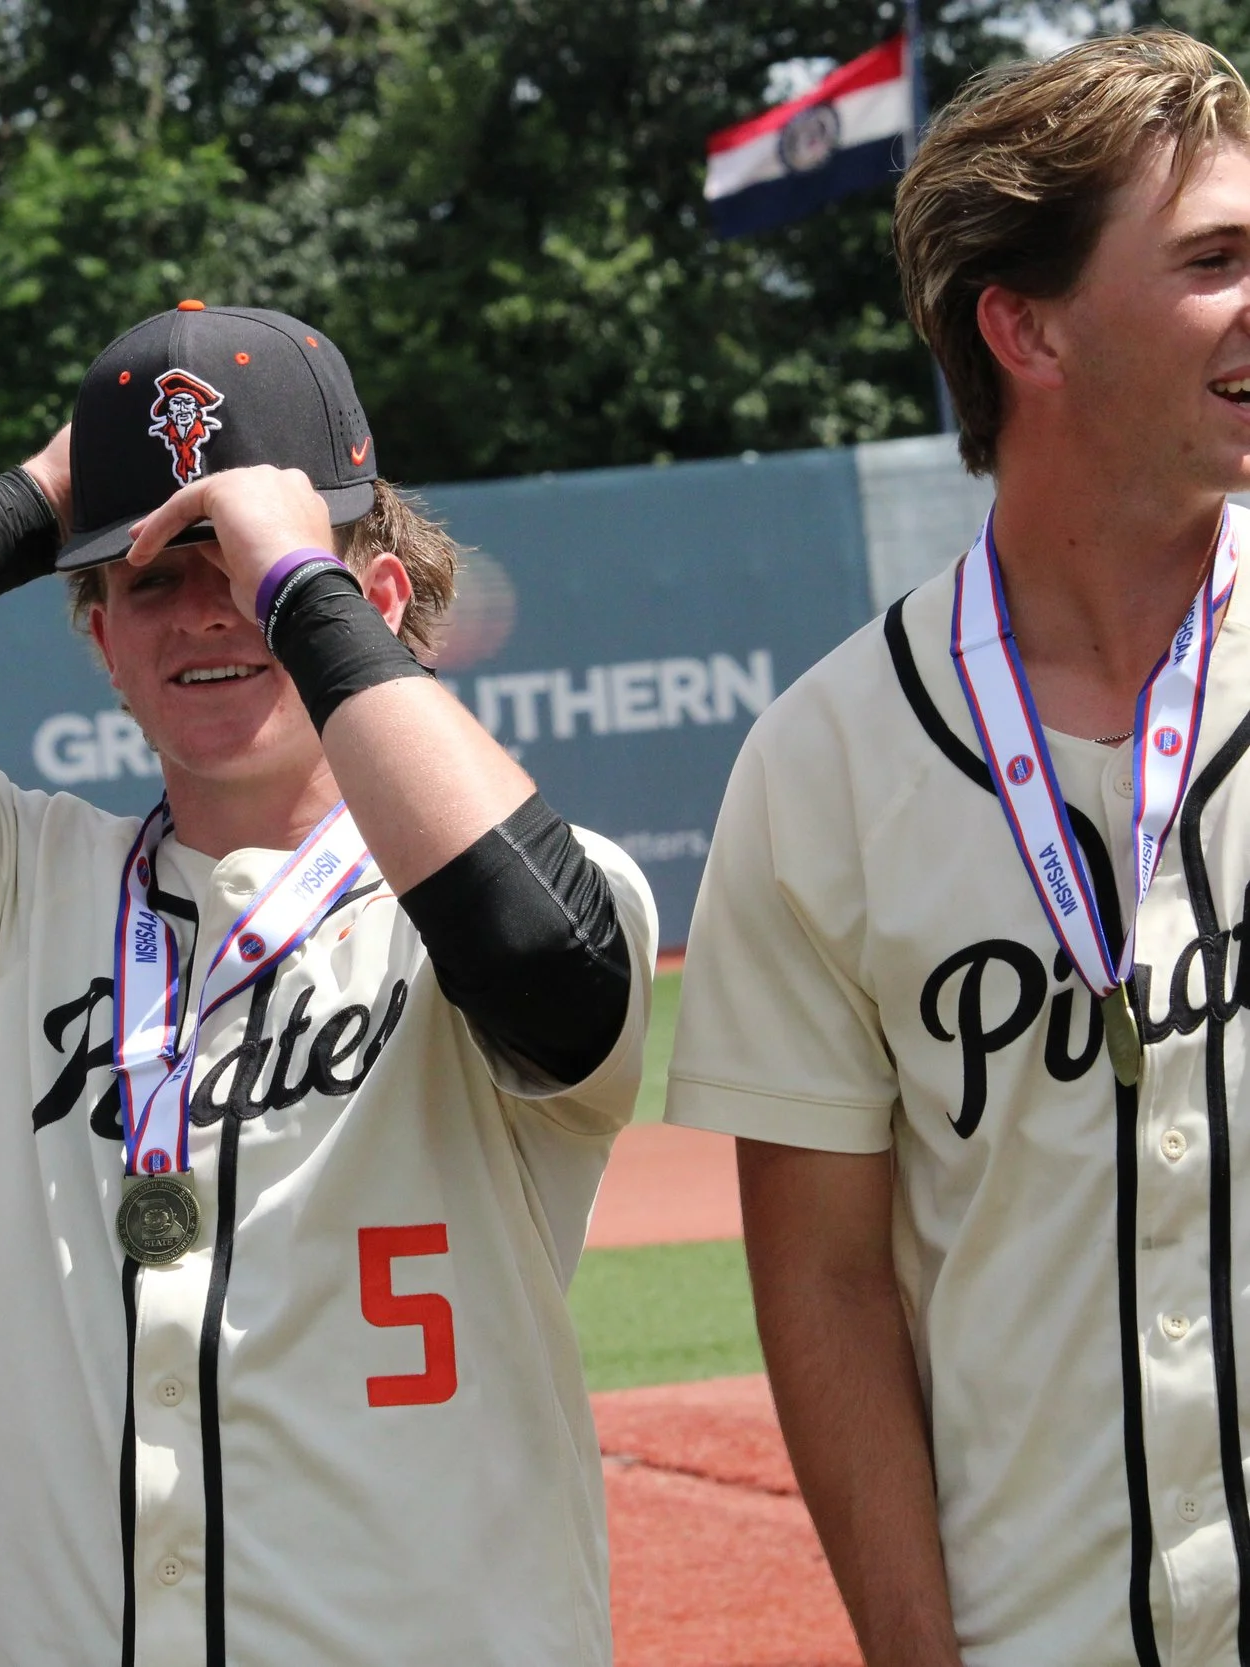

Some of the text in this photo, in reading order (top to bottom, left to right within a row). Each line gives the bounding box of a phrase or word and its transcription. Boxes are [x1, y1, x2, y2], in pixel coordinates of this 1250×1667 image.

[291, 848, 342, 901] MSHSAA
[1038, 842, 1078, 917] MSHSAA
[135, 911, 158, 964] MSHSAA
[144, 1238, 174, 1248] STATE
[357, 1223, 458, 1408] 5
